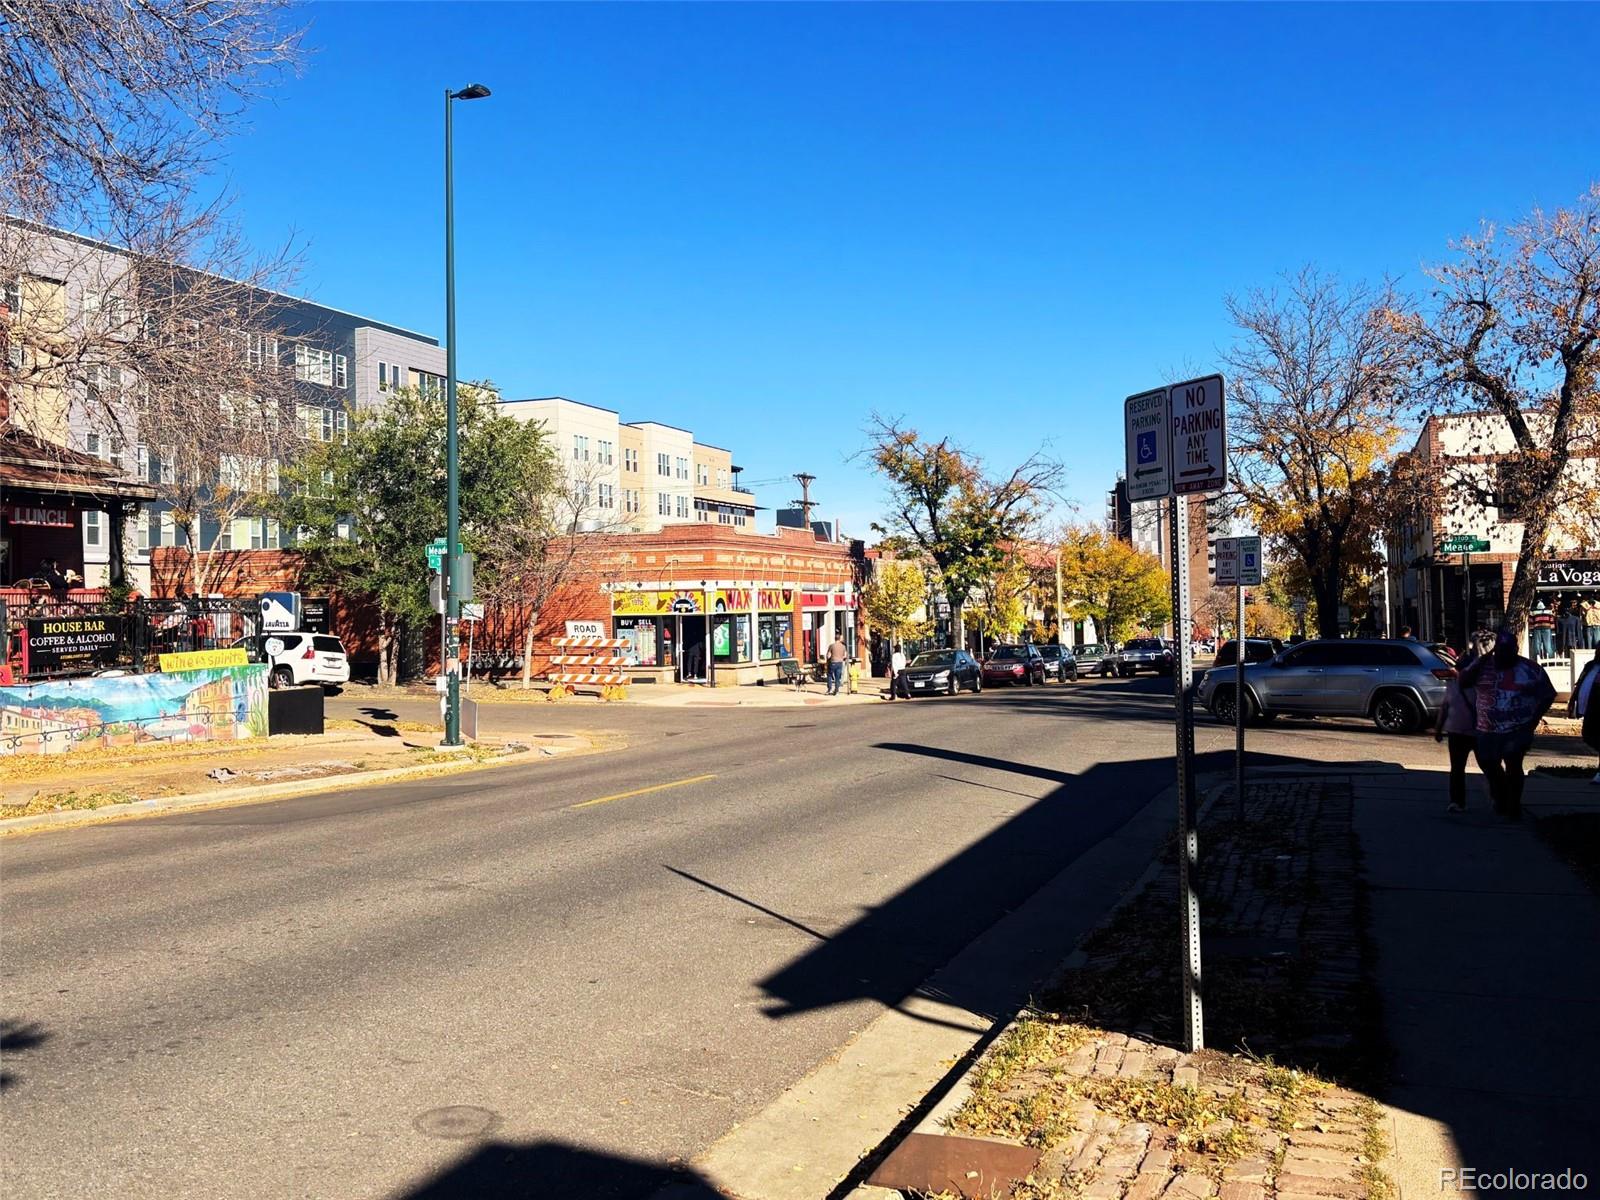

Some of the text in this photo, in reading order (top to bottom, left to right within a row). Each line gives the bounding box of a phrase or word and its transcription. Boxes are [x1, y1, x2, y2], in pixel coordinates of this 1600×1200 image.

[1129, 395, 1163, 415] RESERVED
[1186, 385, 1206, 409] NO
[1131, 412, 1161, 431] PARKING
[1174, 408, 1220, 437] PARKING
[1187, 433, 1207, 450] ANY
[1186, 449, 1209, 465] TIME
[15, 507, 67, 523] LUNCH
[1222, 541, 1231, 550] NO
[1537, 569, 1559, 583] La
[725, 590, 781, 610] WAX TRAX
[43, 620, 106, 634] HOUSE BAR
[574, 624, 597, 633] ROAD
[29, 635, 66, 647] COFFEE
[66, 636, 75, 644] &
[52, 644, 99, 654] SERVED DAILY
